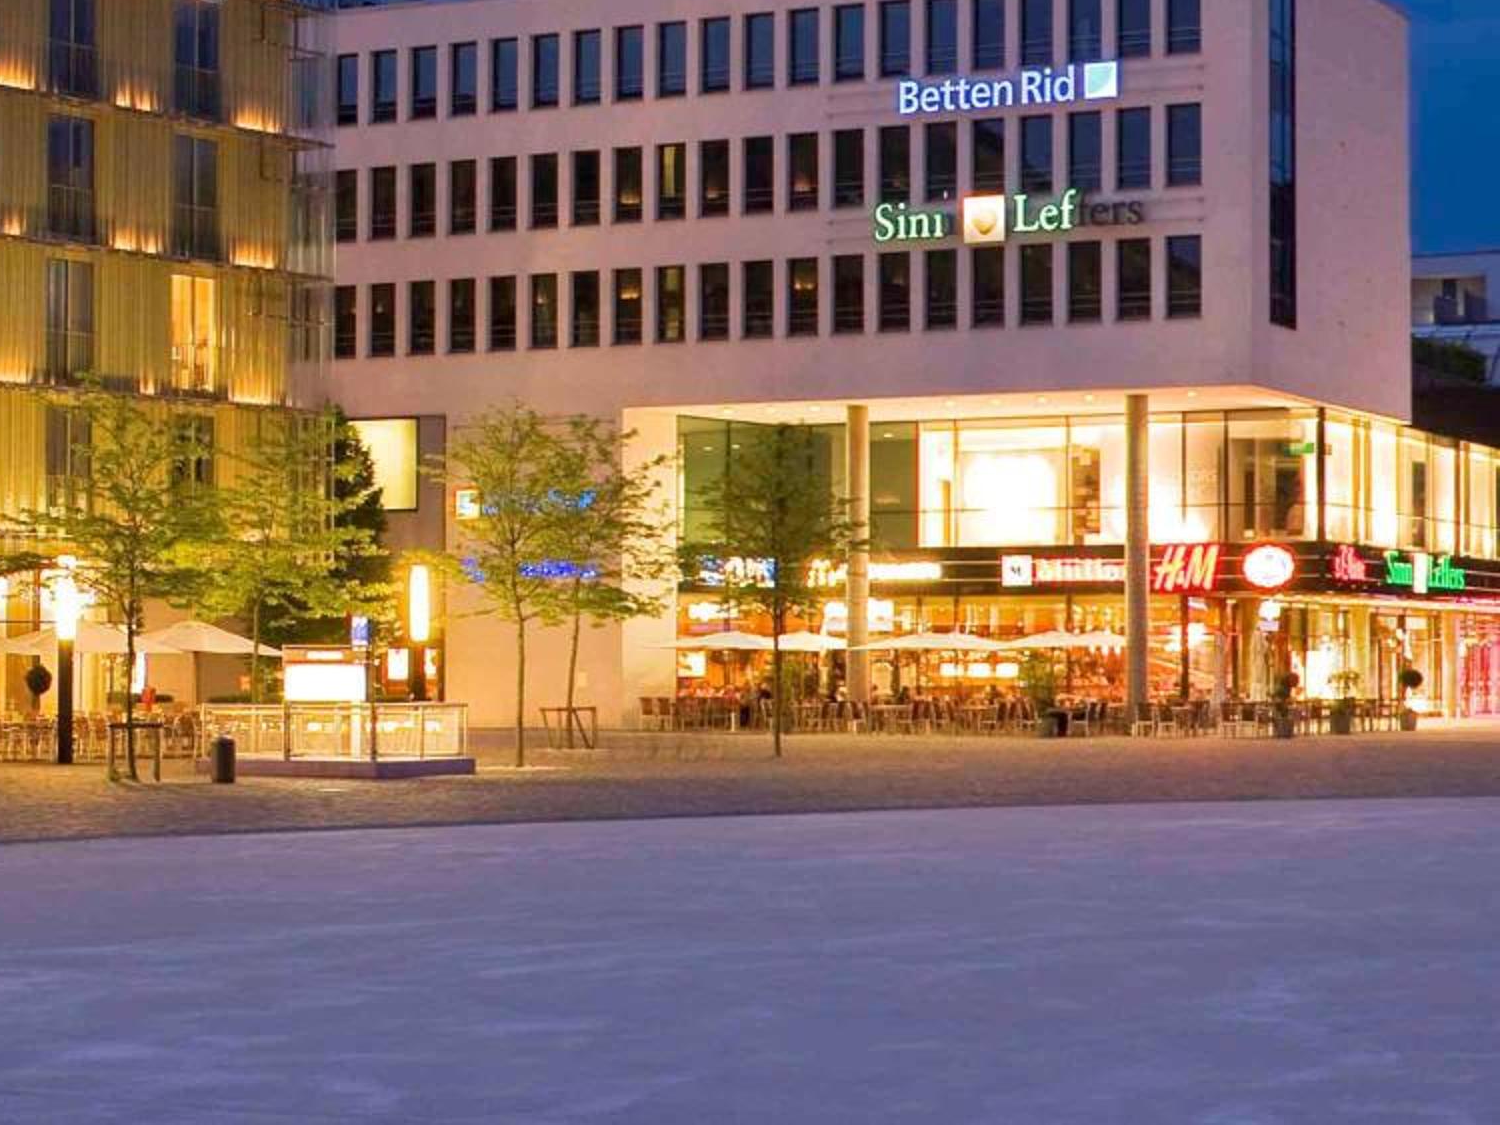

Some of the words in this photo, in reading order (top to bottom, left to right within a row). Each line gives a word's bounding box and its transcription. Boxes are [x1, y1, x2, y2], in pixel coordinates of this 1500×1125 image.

[899, 78, 1014, 114] Betten
[1021, 64, 1075, 104] Rid
[1153, 544, 1219, 591] H&M
